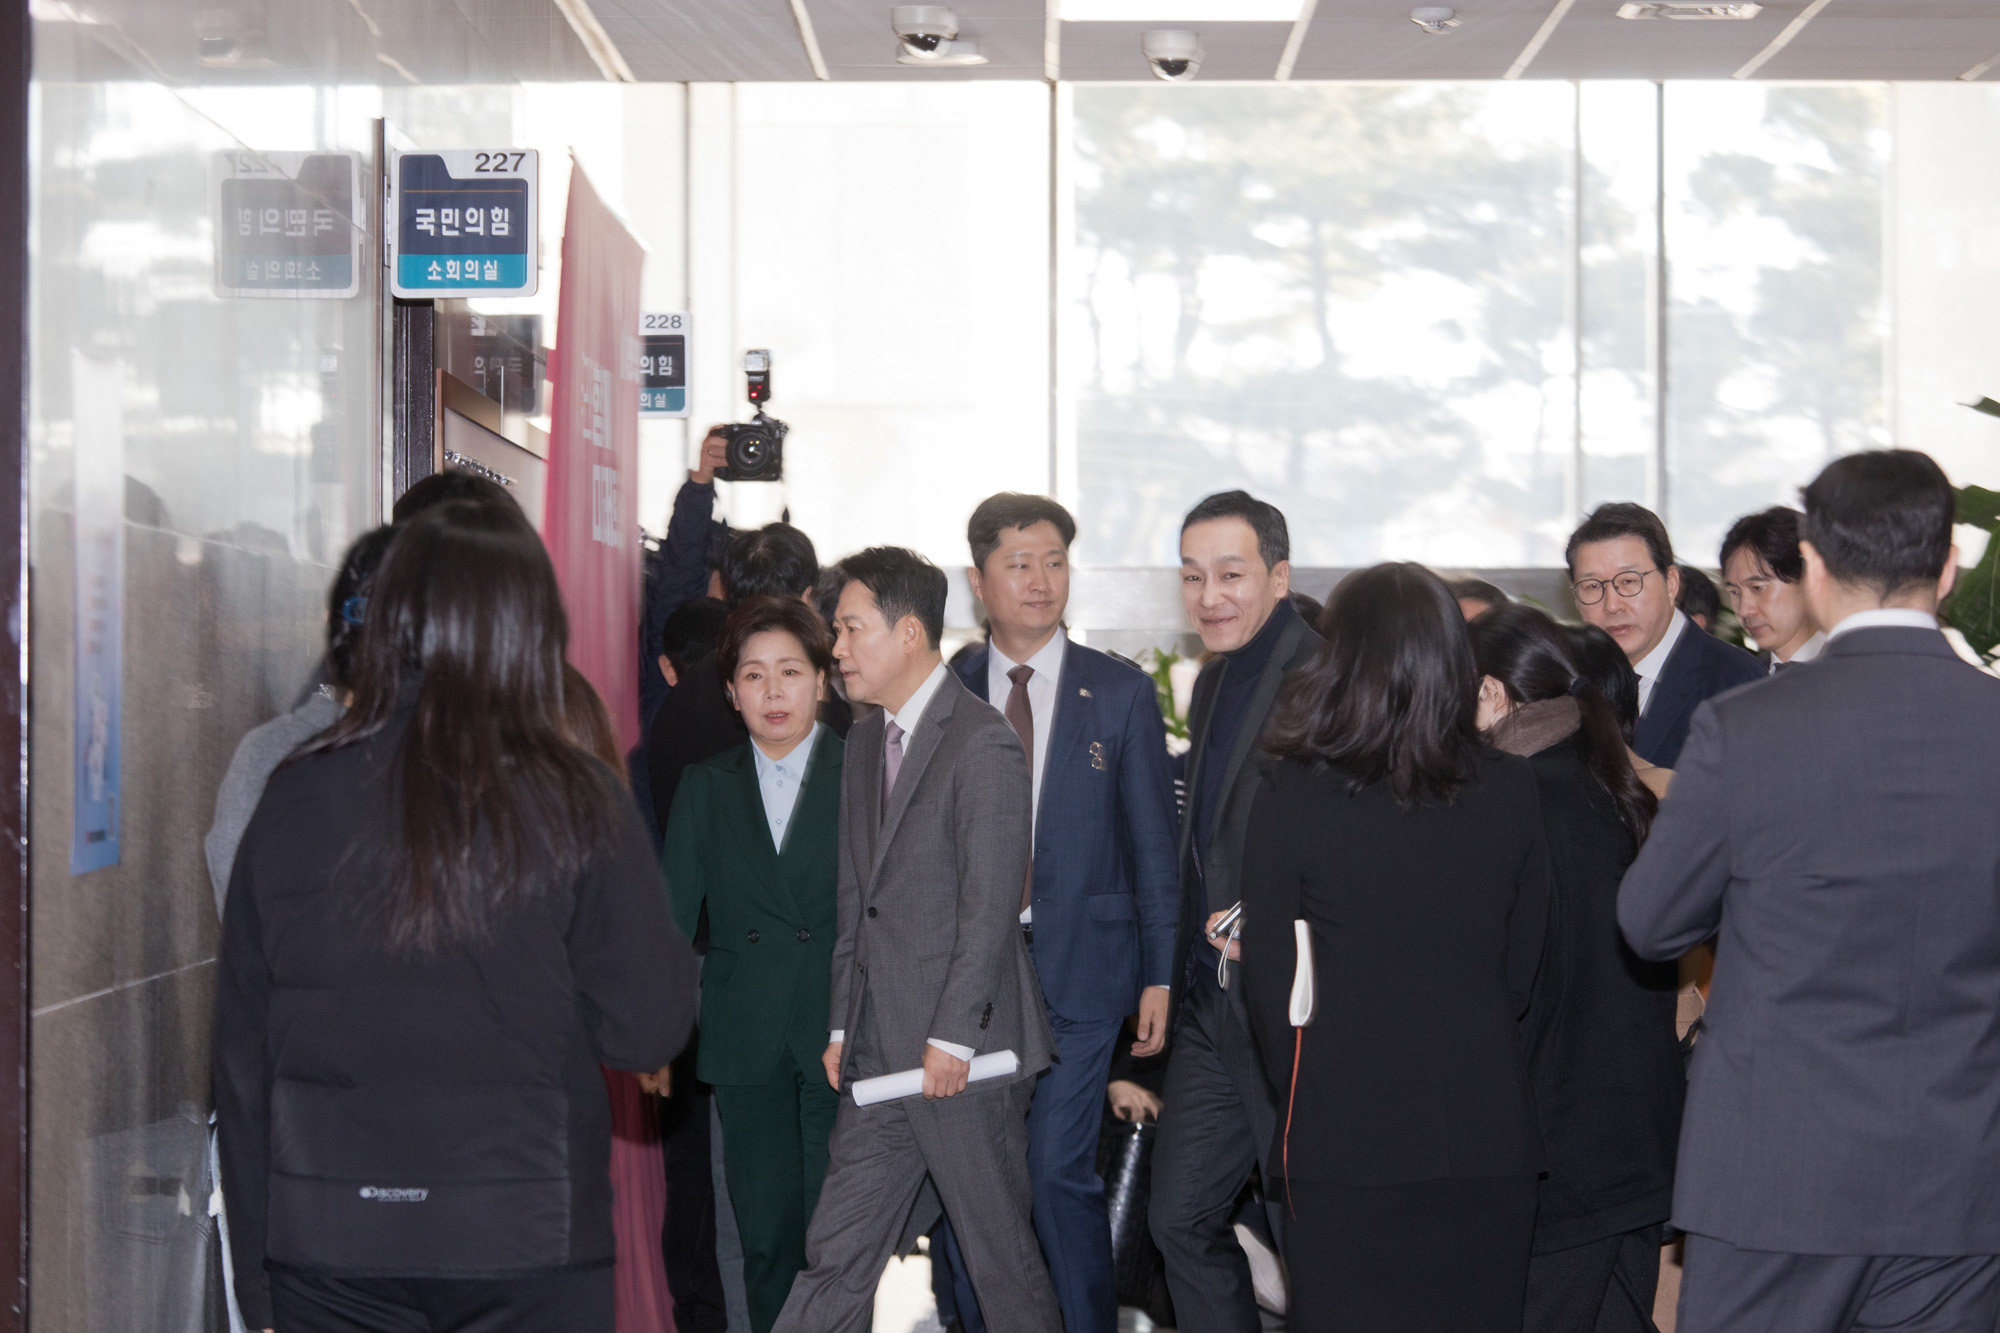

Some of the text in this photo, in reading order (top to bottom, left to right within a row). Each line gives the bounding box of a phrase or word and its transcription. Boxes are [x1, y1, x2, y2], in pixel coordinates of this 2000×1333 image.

[474, 152, 526, 173] 227
[415, 206, 510, 237] 국민의힘
[427, 259, 498, 281] 소회의실
[644, 314, 682, 329] 228
[639, 355, 673, 376] 의힘
